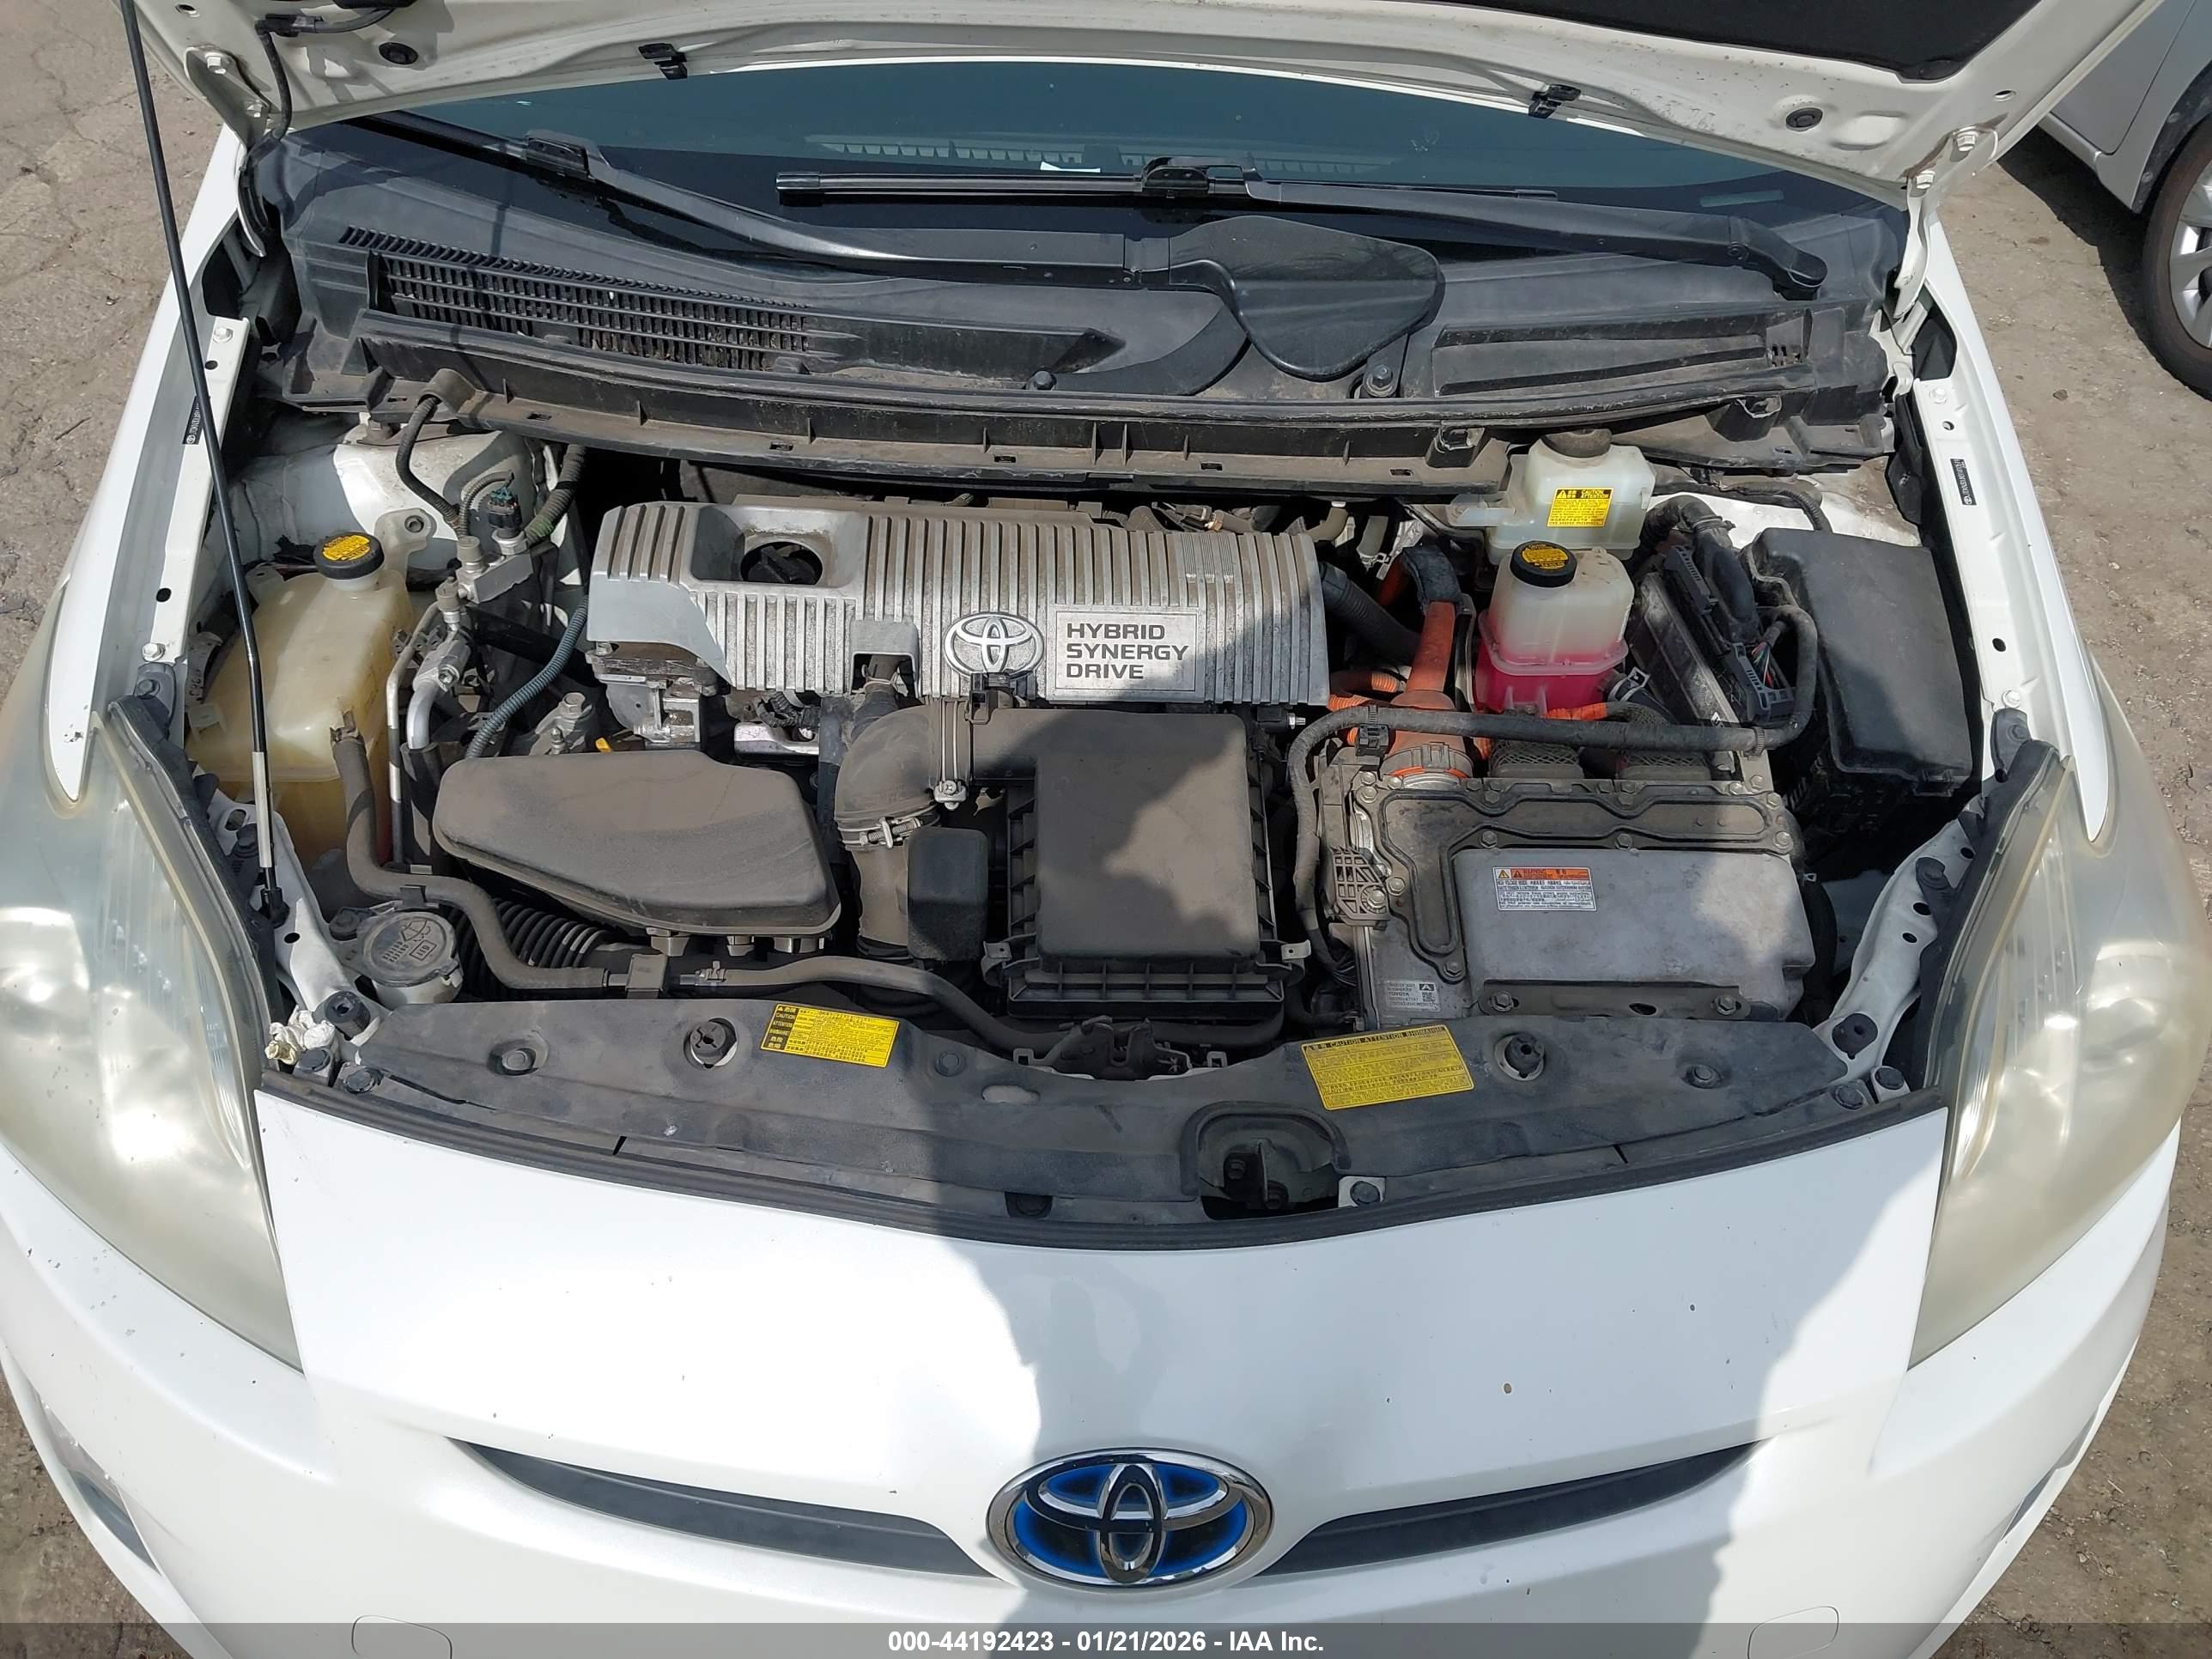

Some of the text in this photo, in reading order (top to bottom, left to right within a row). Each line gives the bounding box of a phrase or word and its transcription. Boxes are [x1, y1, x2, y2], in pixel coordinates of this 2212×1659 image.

[1066, 623, 1165, 640] HYBRID
[1066, 643, 1188, 660] SYNERGY
[1066, 663, 1144, 679] DRIVE
[1330, 1038, 1361, 1047] CAUTION
